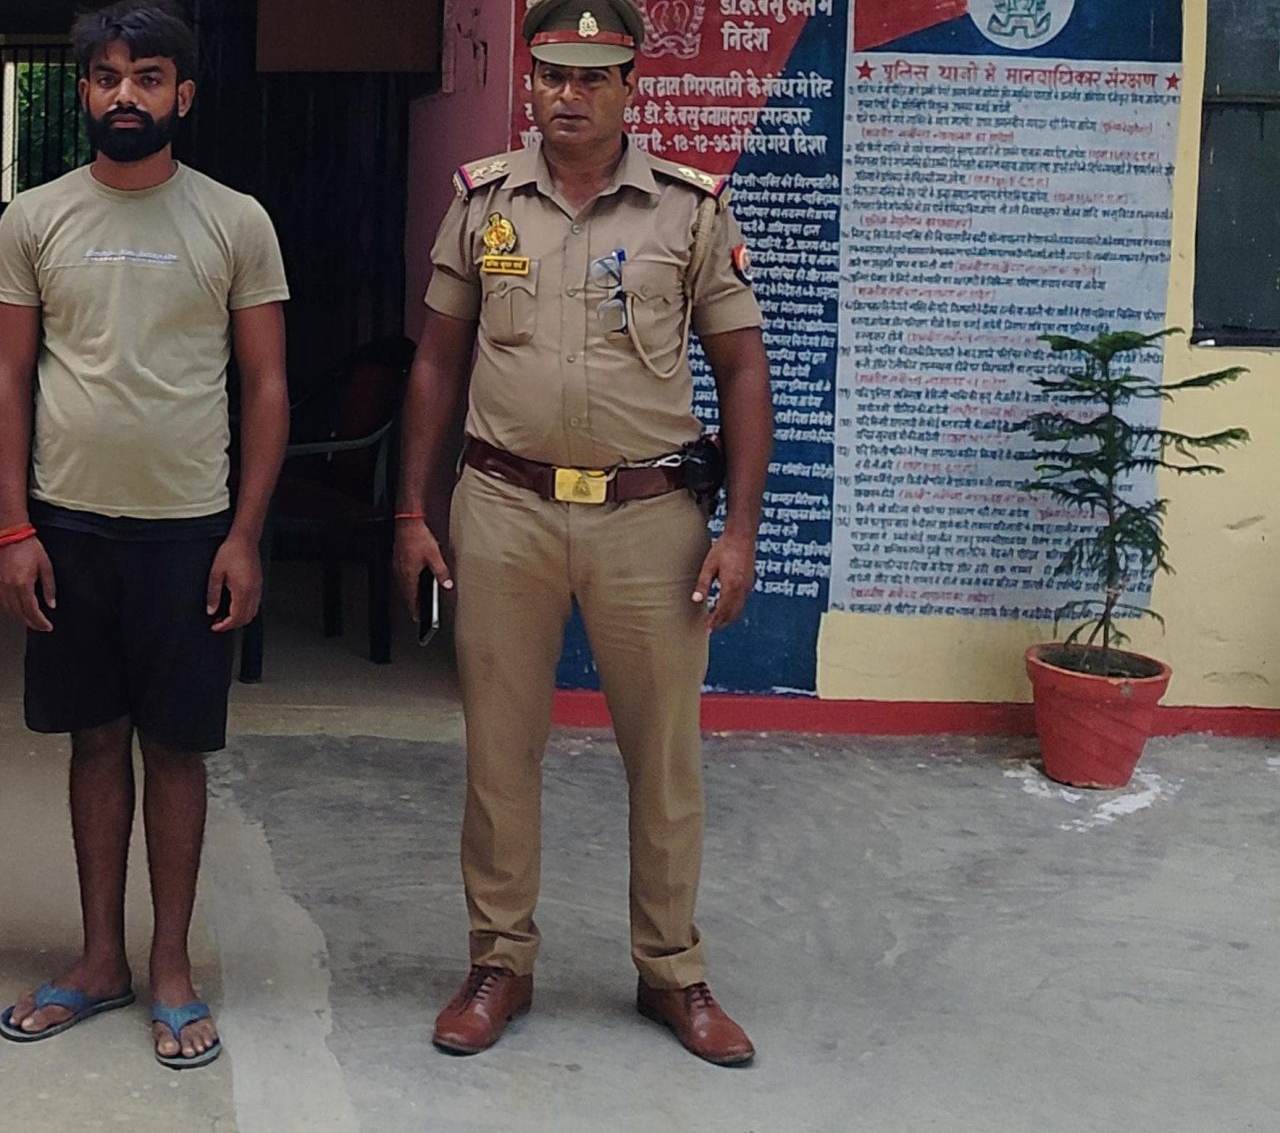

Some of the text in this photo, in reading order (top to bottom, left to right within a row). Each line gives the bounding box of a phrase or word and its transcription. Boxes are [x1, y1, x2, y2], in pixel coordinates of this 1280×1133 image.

[720, 20, 771, 52] निर्देश
[682, 71, 744, 97] गिरफ्तारी
[746, 69, 761, 97] के
[882, 60, 929, 84] पुलिस
[1104, 66, 1158, 90] संरक्षण
[760, 108, 812, 127] सरकार
